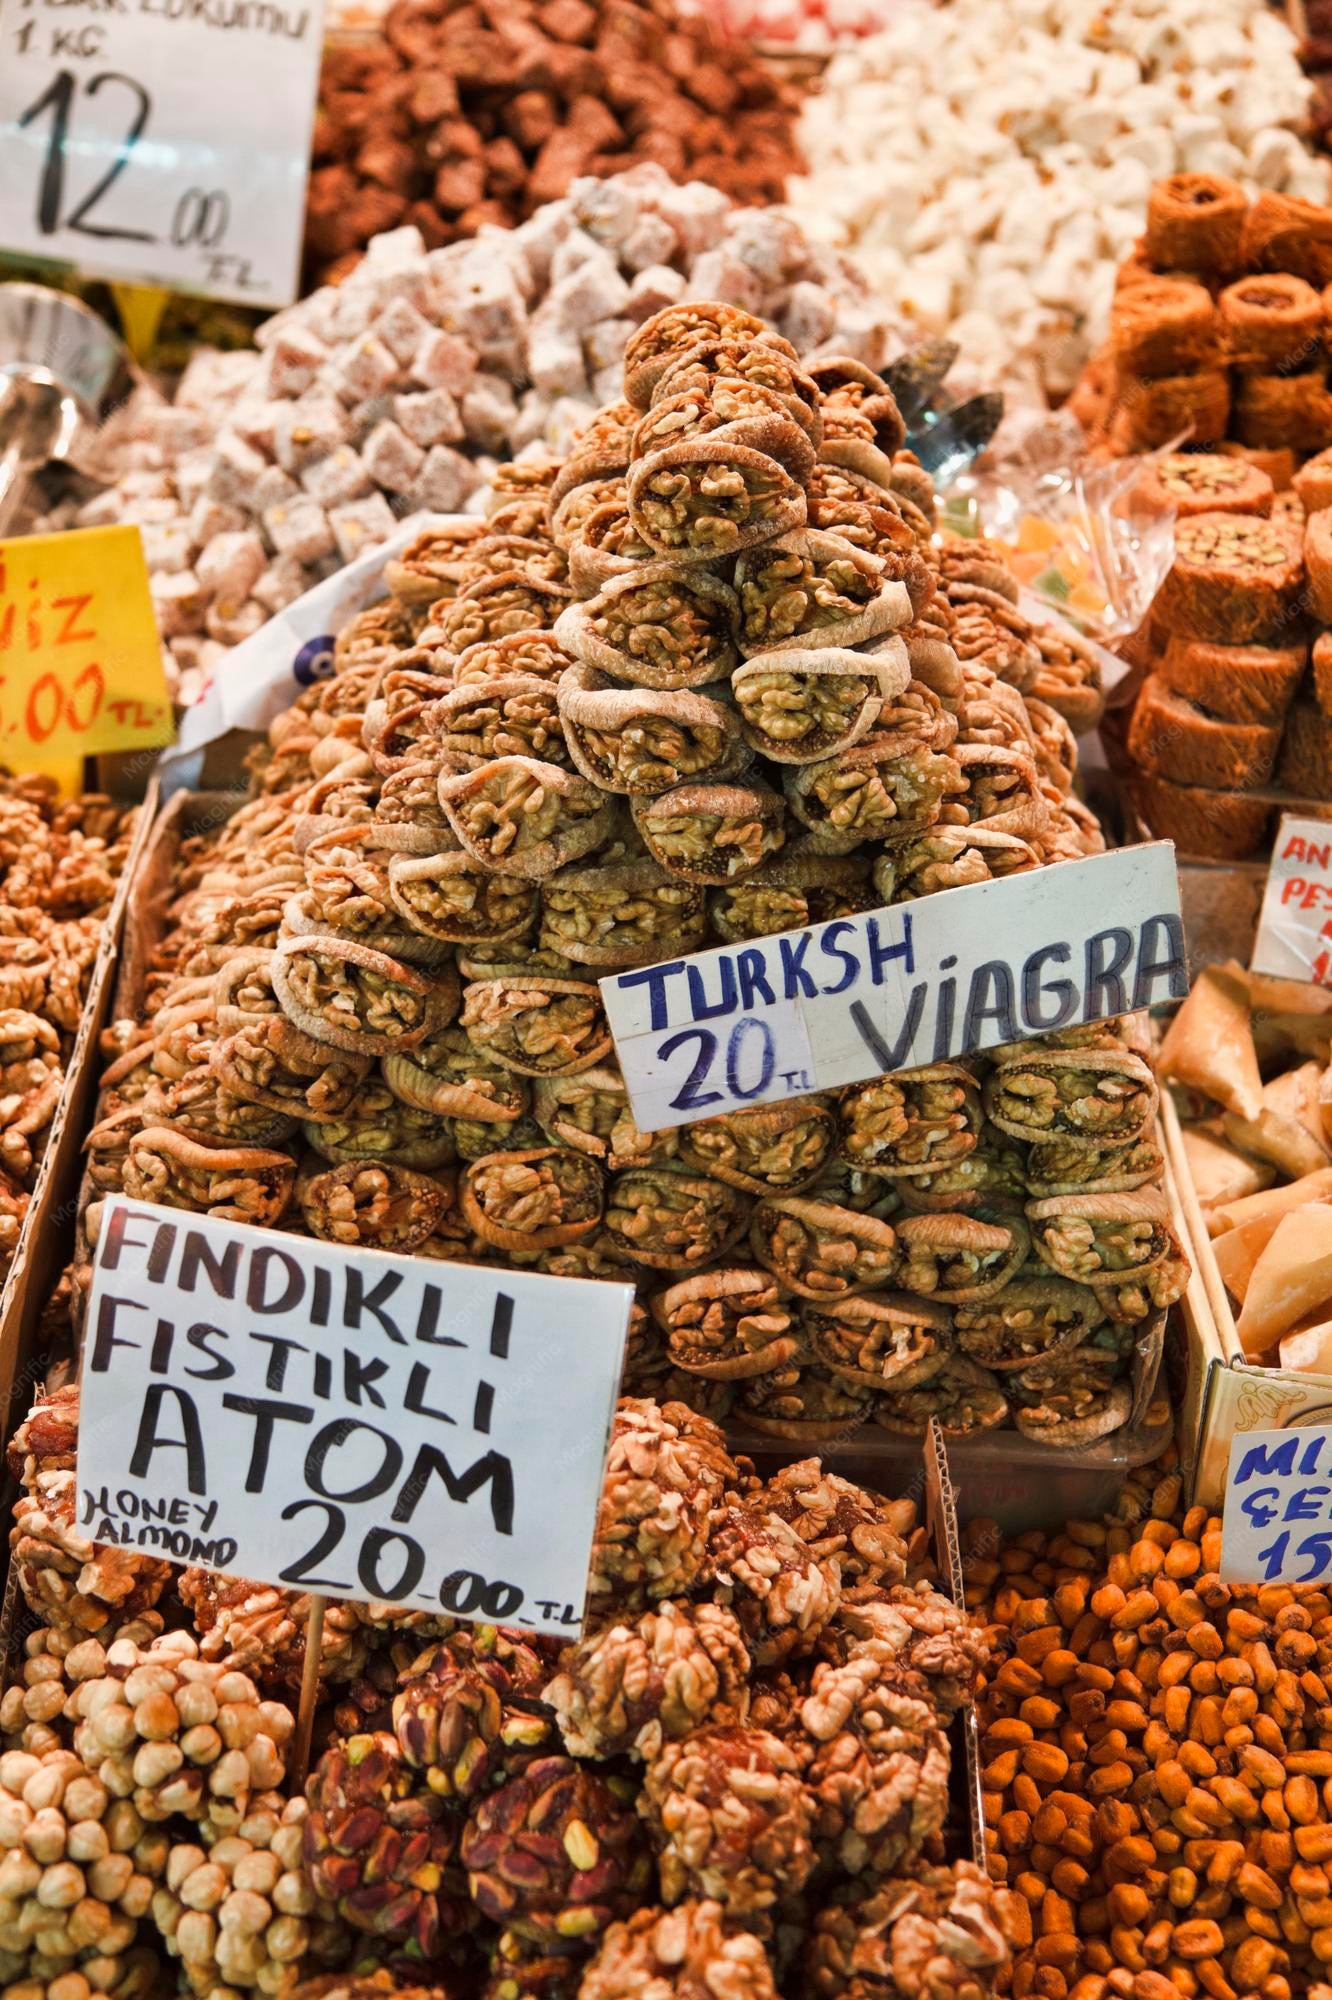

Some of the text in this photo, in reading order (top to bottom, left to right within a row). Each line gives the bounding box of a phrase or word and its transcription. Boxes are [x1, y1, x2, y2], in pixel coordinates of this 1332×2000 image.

[617, 912, 915, 1032] TURKSH
[100, 1206, 515, 1360] FINDIKLI
[90, 1293, 496, 1435] FISTIKLI
[80, 1486, 218, 1533] HONEY
[128, 1382, 515, 1537] ATOM
[1233, 1435, 1332, 1485] MI
